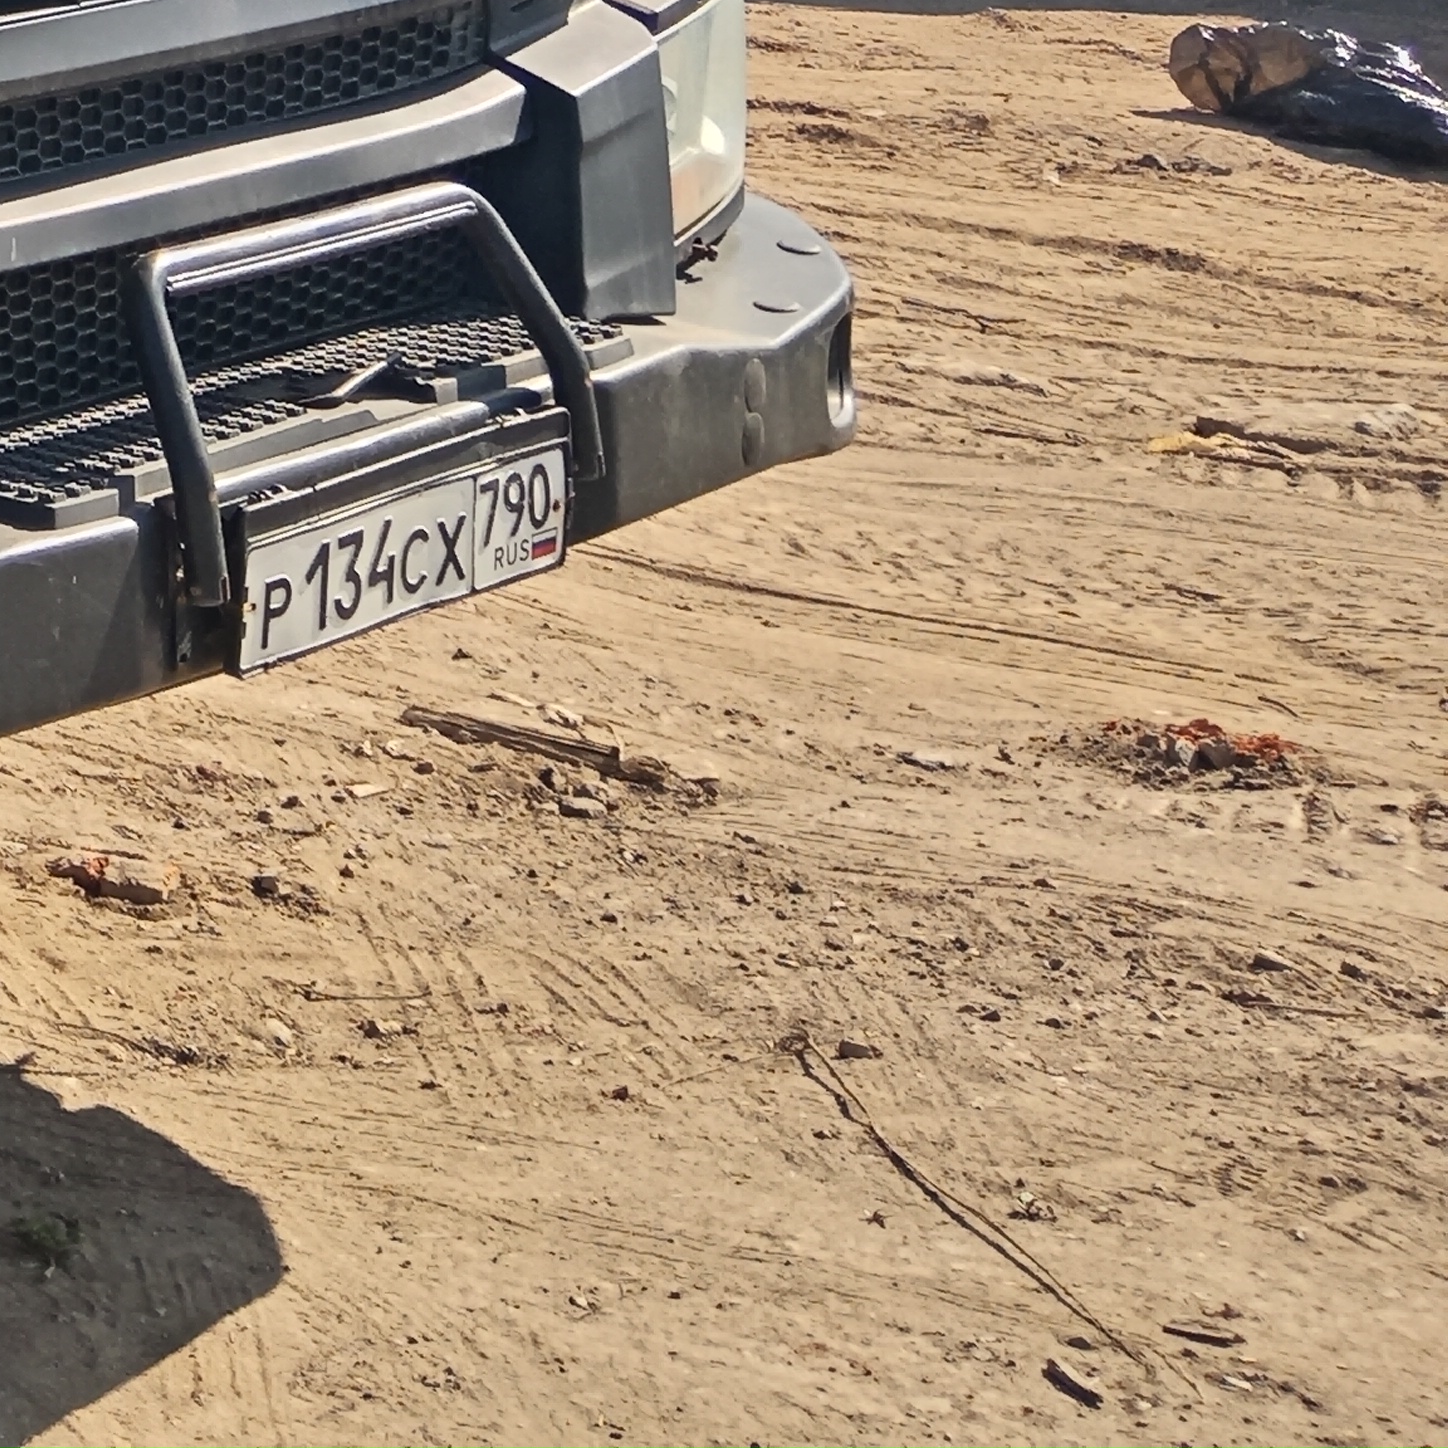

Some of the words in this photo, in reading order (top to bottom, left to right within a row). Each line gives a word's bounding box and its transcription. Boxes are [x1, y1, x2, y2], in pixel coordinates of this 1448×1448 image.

[259, 510, 467, 650] Р134СХ
[479, 462, 552, 549] 790
[493, 537, 531, 571] RUS
